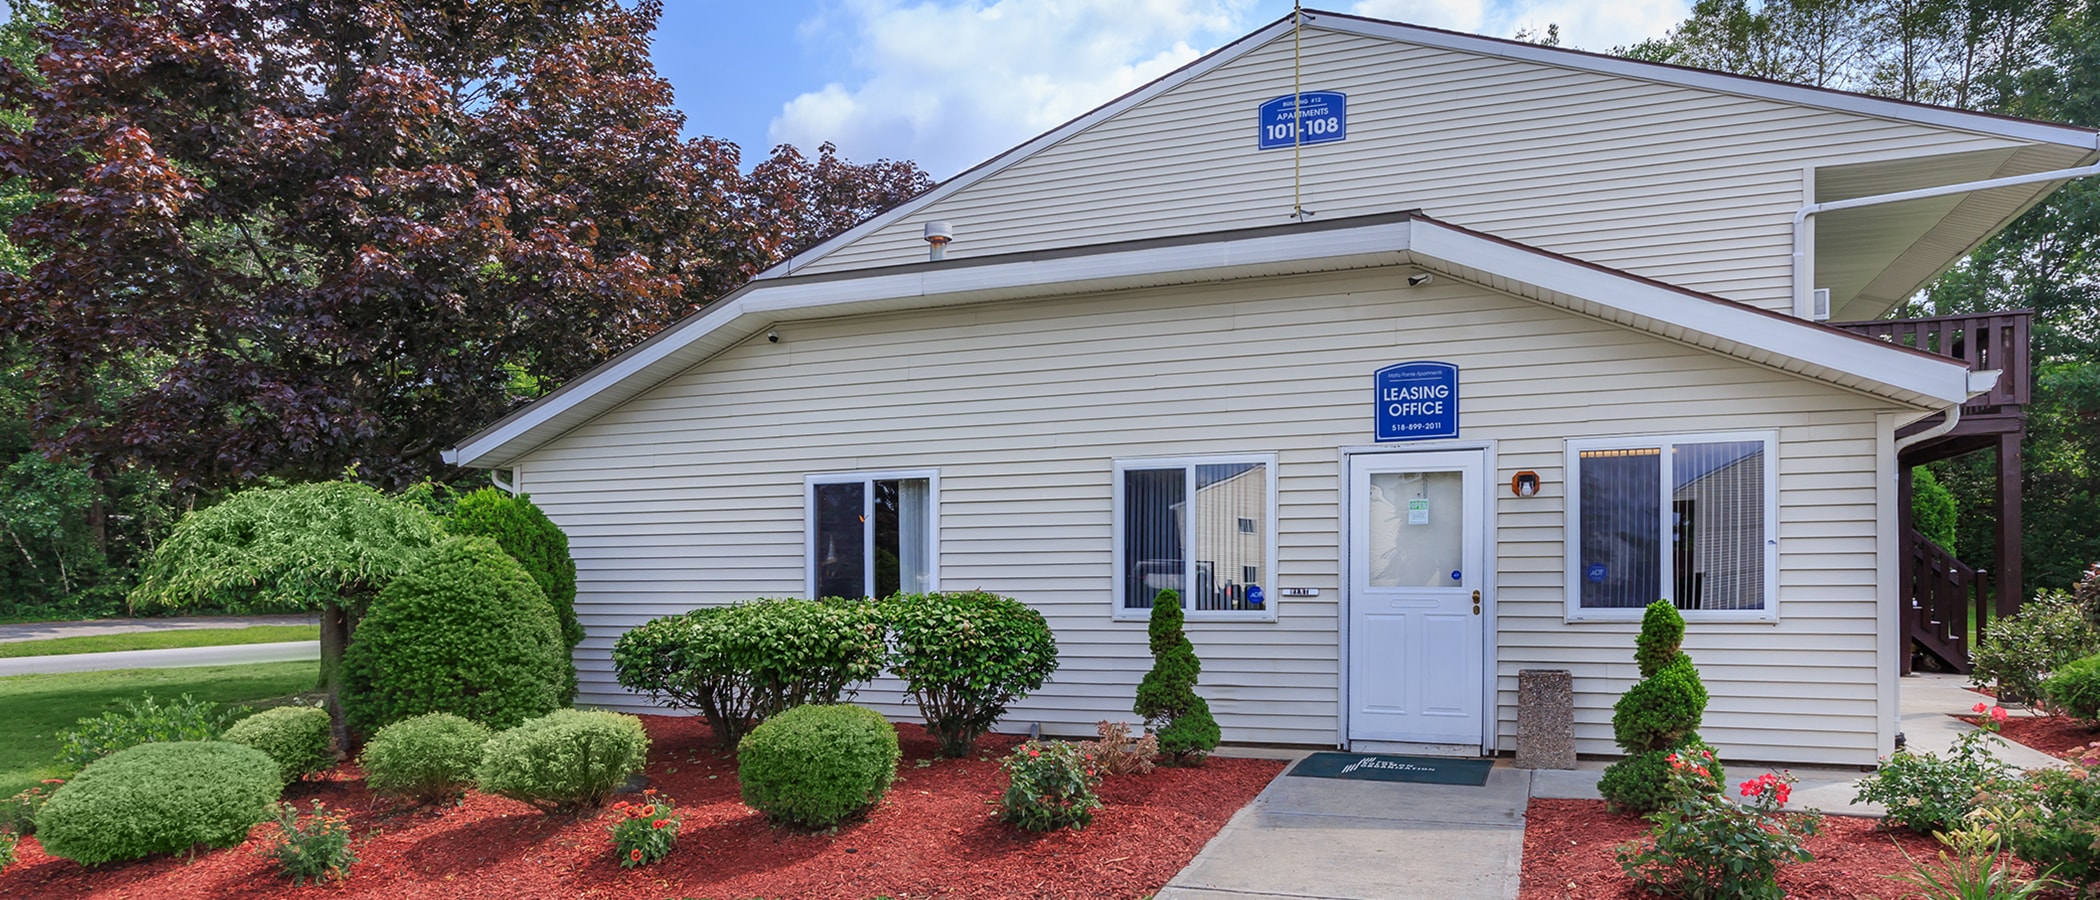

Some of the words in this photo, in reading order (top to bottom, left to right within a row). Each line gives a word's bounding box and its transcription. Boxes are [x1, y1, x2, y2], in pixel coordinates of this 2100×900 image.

[1283, 99, 1309, 107] BUILDNG
[1266, 117, 1339, 140] 101-108
[1383, 385, 1449, 401] LEASING
[1389, 401, 1443, 417] OFFICE
[1391, 422, 1441, 431] 518-899-2011
